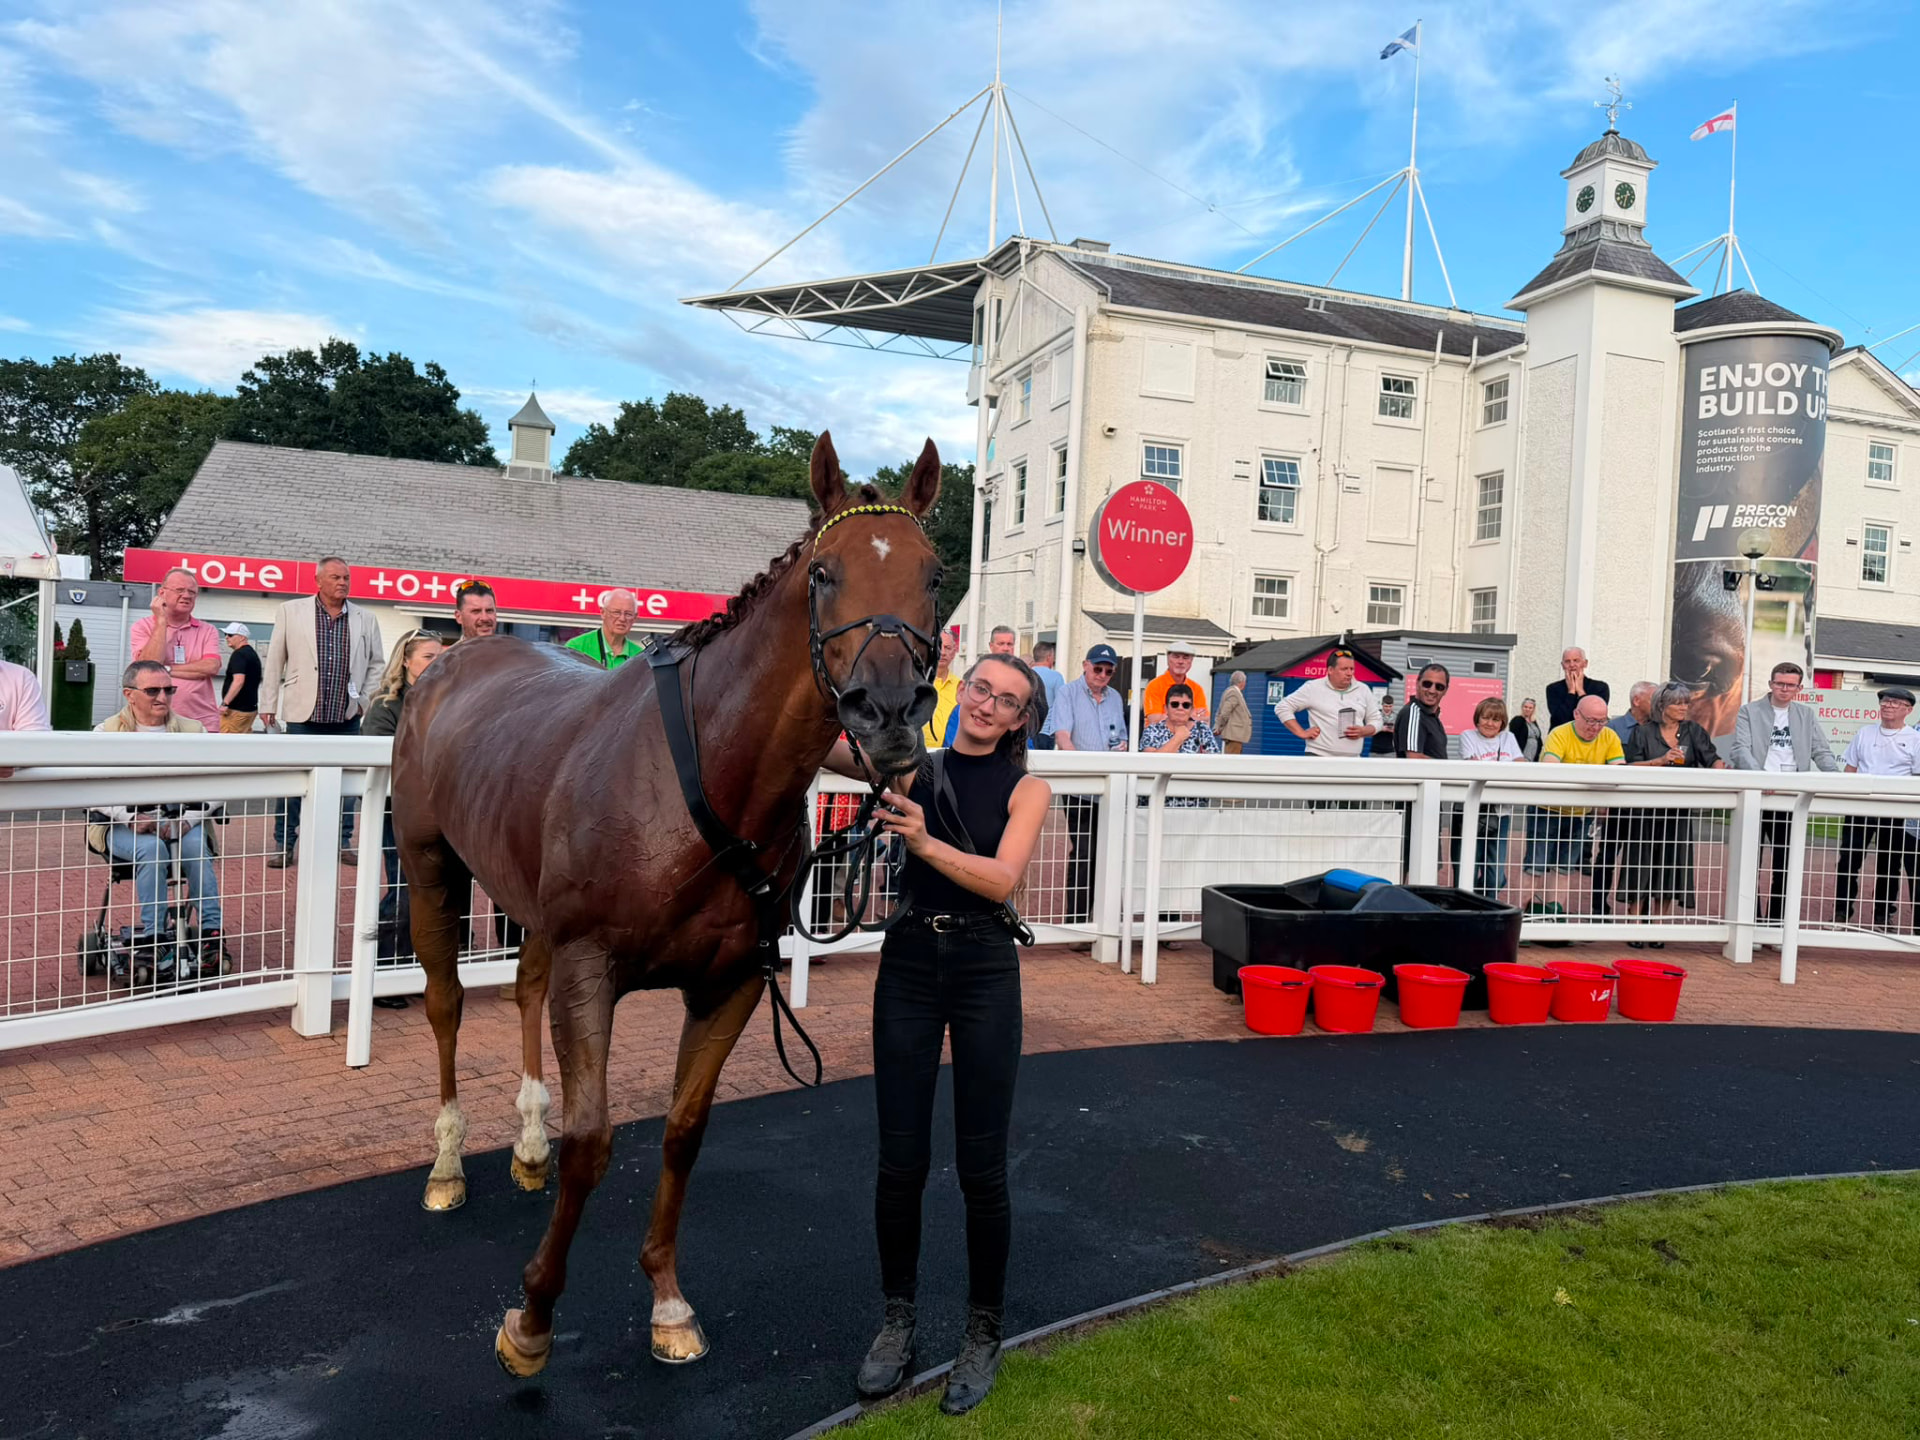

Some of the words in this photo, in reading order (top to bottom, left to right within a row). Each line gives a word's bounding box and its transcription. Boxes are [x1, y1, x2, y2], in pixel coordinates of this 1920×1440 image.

[1700, 362, 1808, 392] ENJOY
[1698, 391, 1799, 419] BUILD
[1698, 426, 1745, 438] Scotland's
[1747, 426, 1766, 434] first
[1767, 426, 1796, 435] choice
[1697, 438, 1711, 447] for
[1712, 435, 1765, 445] sustainable
[1766, 436, 1803, 445] concrete
[1697, 445, 1738, 457] products
[1739, 444, 1754, 452] for
[1755, 444, 1771, 452] the
[1696, 454, 1755, 464] construction
[1696, 464, 1736, 474] industry.
[1129, 496, 1168, 506] HAMILTON
[1139, 503, 1158, 512] PARK
[1735, 504, 1798, 517] PRECON
[1731, 516, 1787, 528] BRICKS
[1107, 517, 1187, 547] Winner
[1818, 707, 1860, 719] RECYCLE
